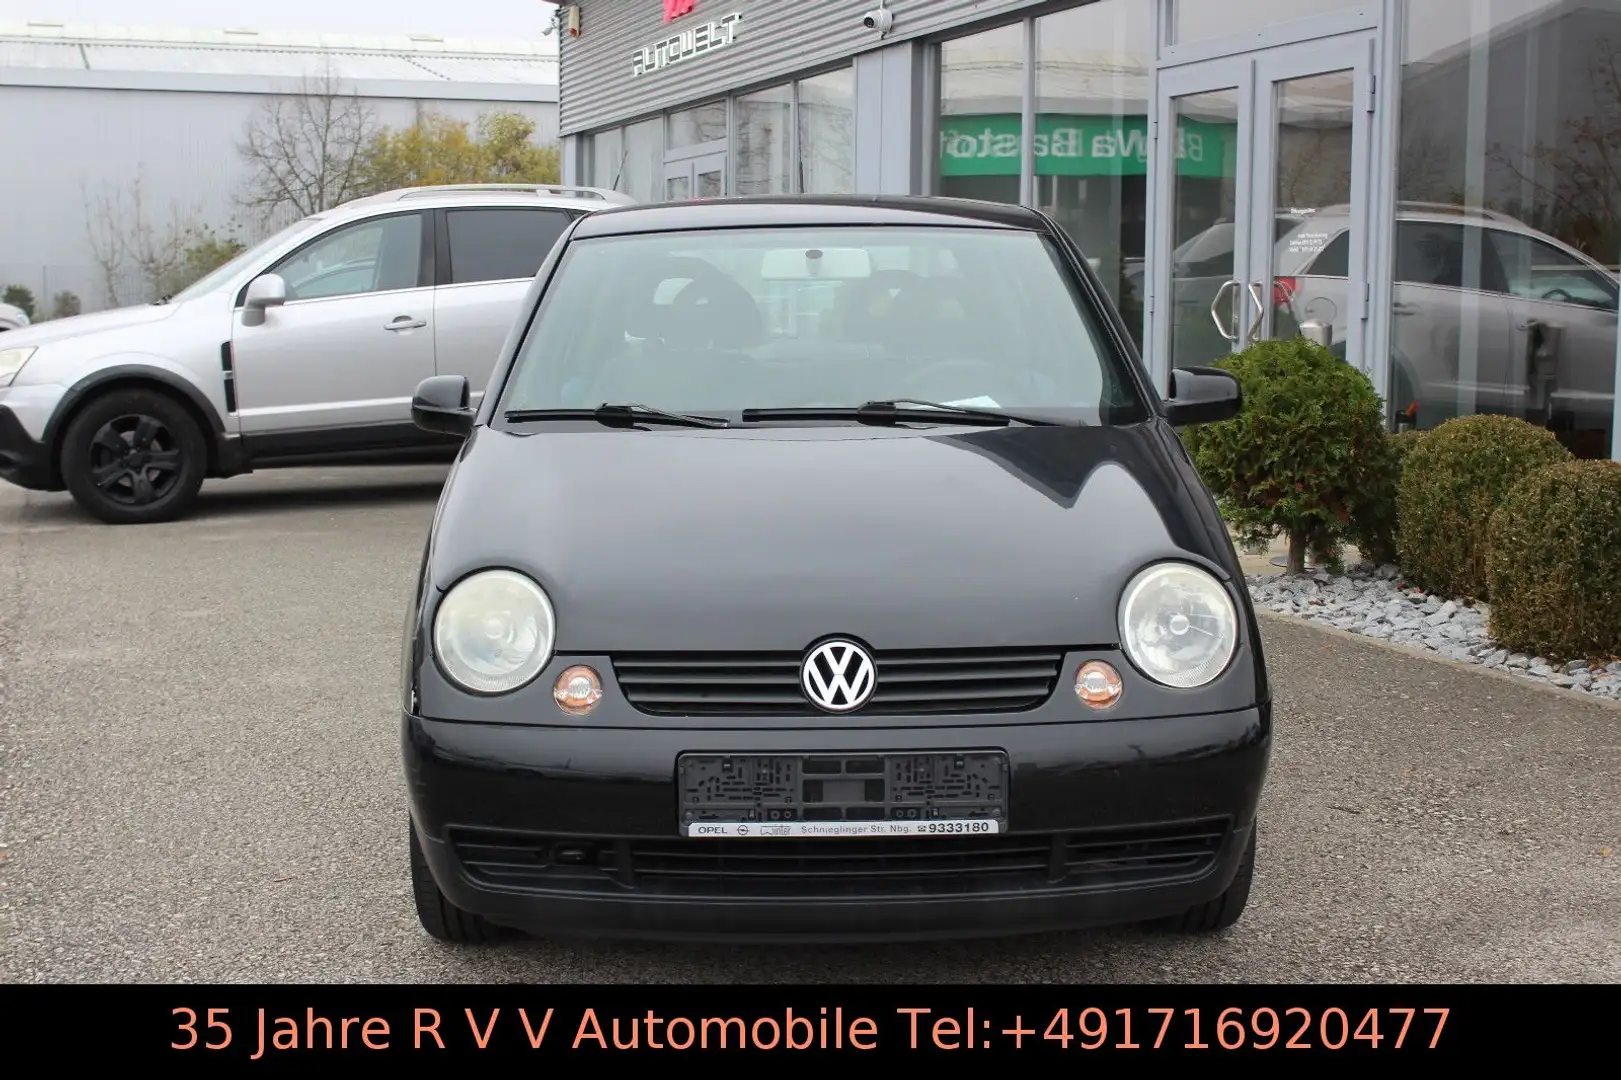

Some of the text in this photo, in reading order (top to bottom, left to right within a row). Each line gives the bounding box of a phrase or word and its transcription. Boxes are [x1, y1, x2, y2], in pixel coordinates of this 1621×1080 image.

[632, 12, 741, 77] AUTOWELT
[698, 826, 728, 835] OPEL
[801, 824, 867, 835] Schnieglinger
[870, 824, 886, 833] Str.
[889, 824, 912, 834] Nbg.
[928, 821, 990, 833] 9333180
